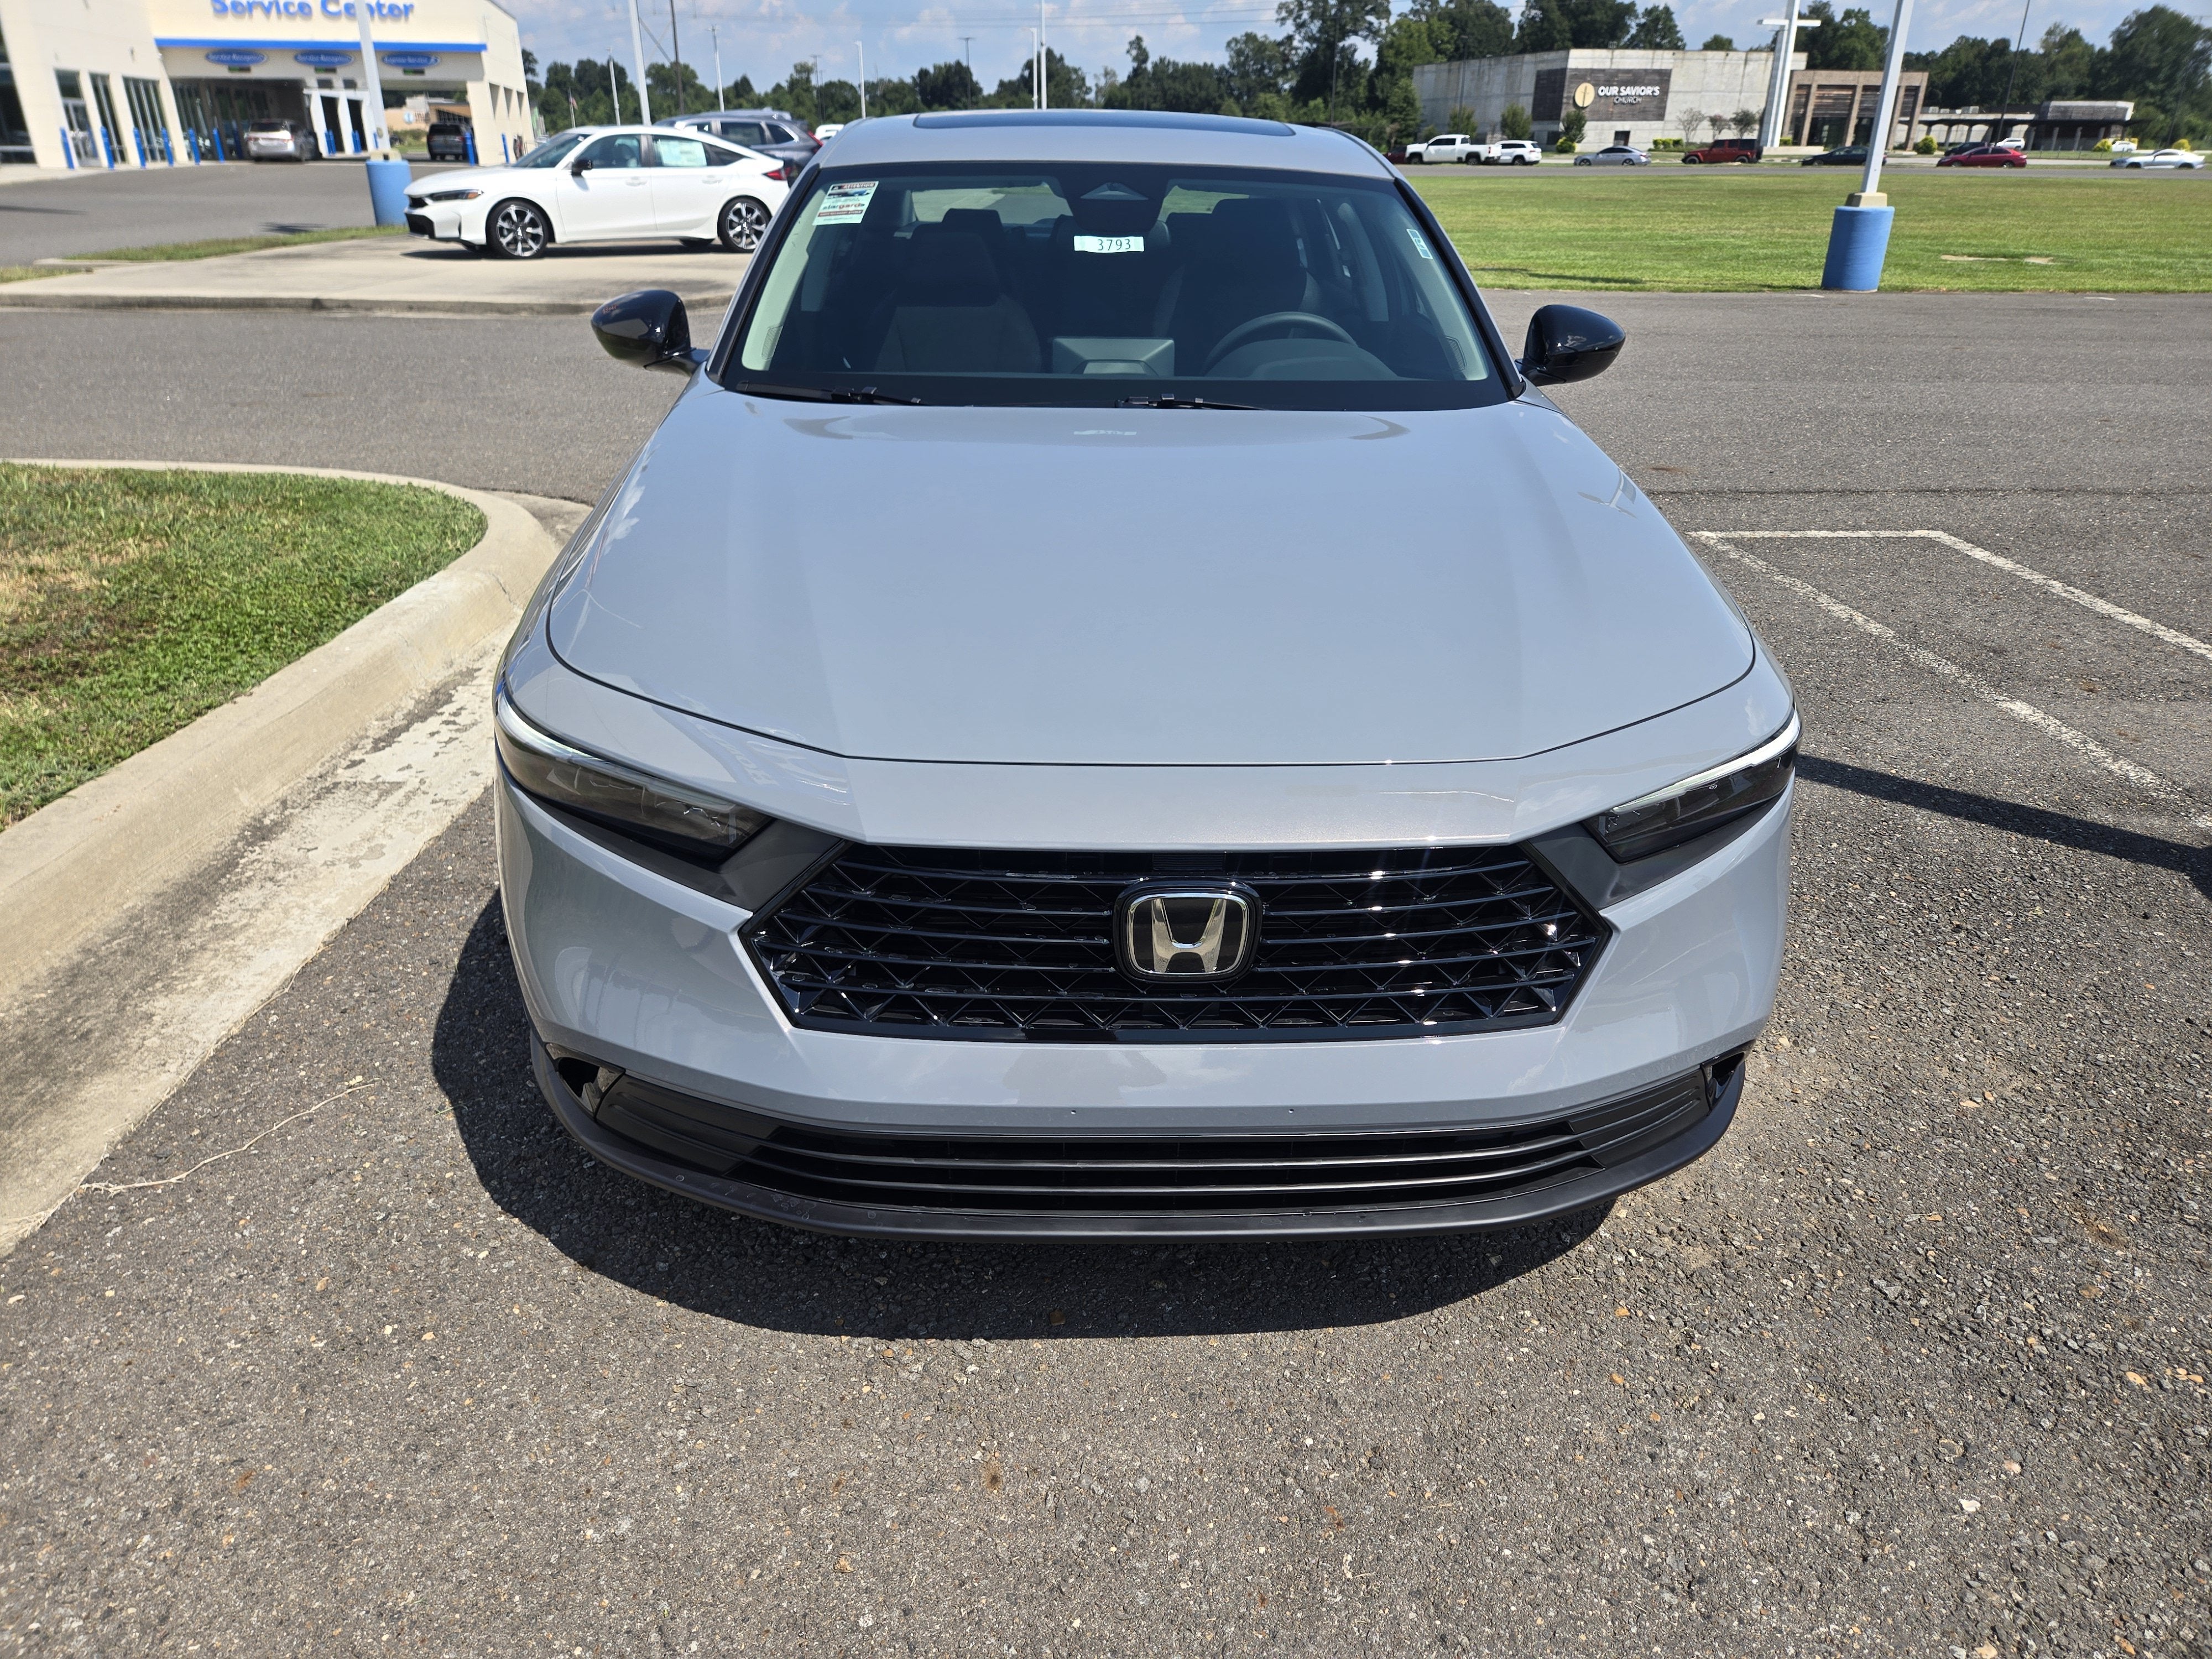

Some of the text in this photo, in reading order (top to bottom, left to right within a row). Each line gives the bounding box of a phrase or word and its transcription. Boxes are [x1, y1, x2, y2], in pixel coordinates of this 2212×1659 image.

[212, 0, 313, 17] Service
[1598, 86, 1660, 96] OUR SAVIOR'S
[1097, 238, 1131, 251] 3793
